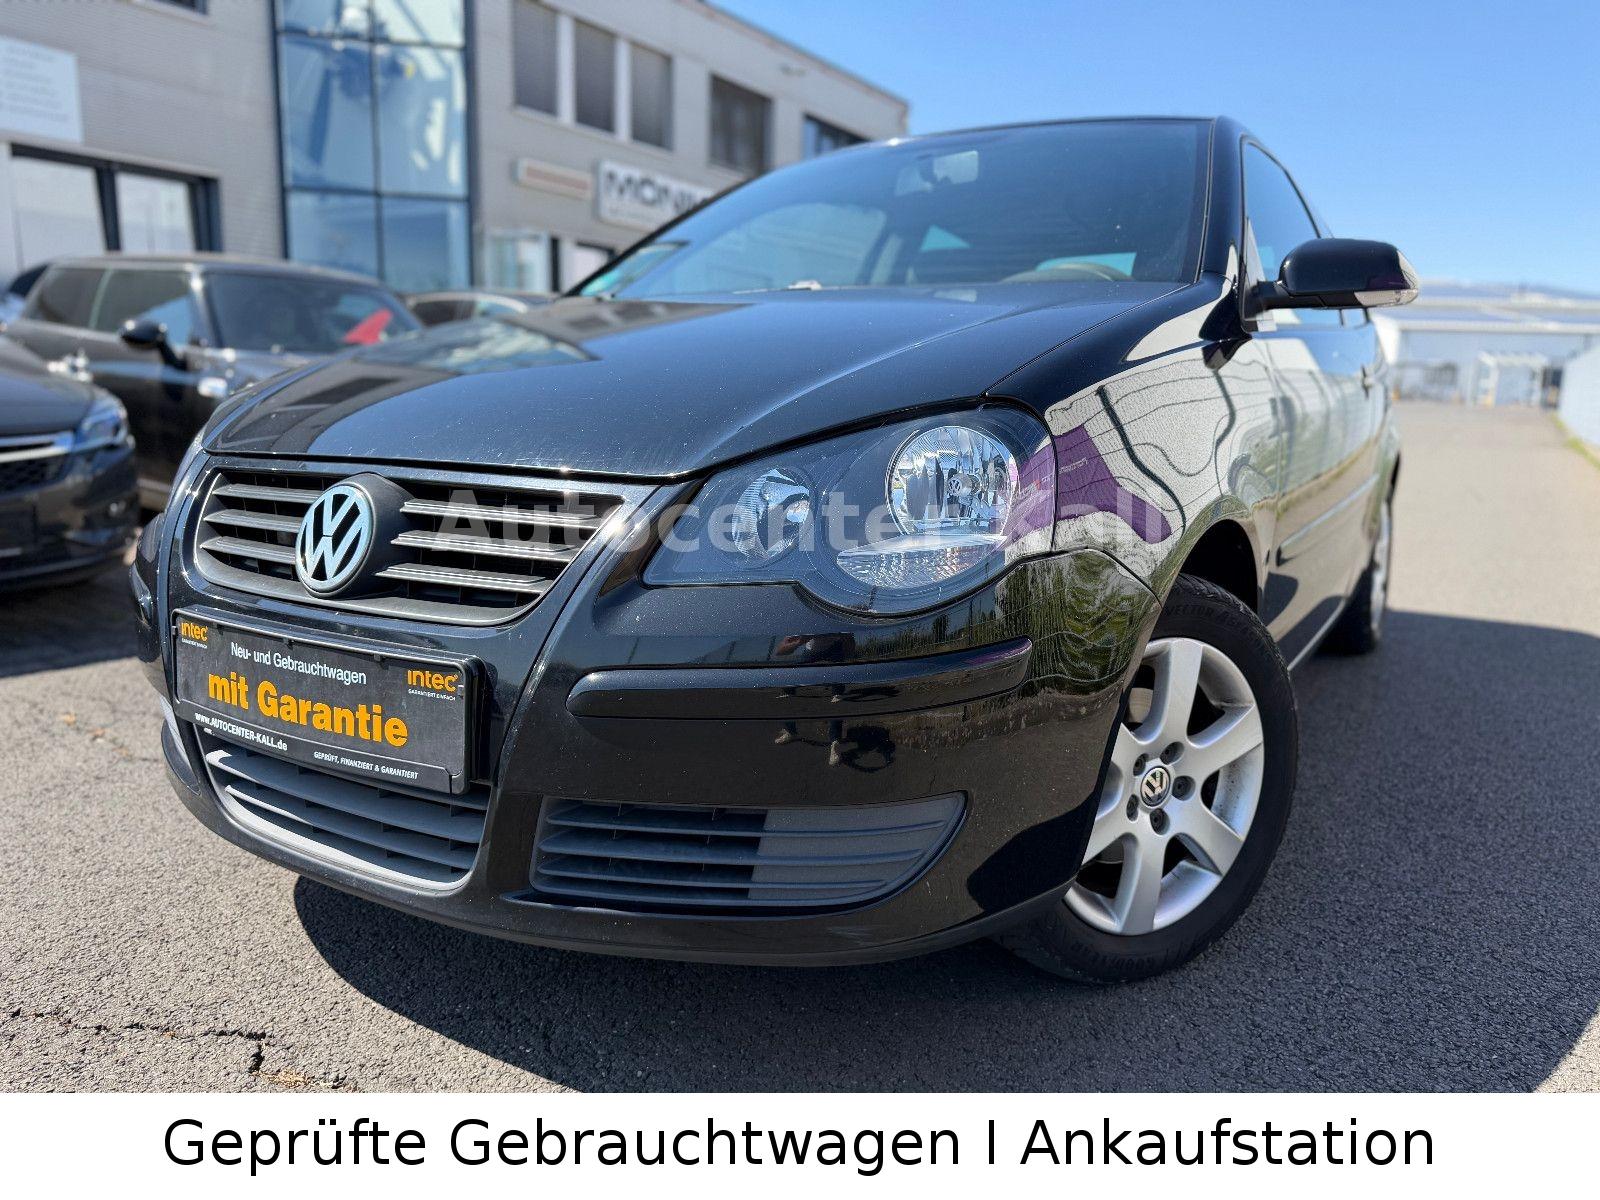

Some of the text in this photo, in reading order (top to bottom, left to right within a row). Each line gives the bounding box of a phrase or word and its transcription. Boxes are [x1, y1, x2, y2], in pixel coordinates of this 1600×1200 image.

[231, 642, 367, 686] Neu- und Gebrauchtwagen
[208, 671, 409, 748] mit Garantie
[194, 712, 288, 751] www.AUTOCENTER-KALL.de
[340, 757, 374, 771] FINANZIERT
[381, 765, 419, 780] GARANTIERT
